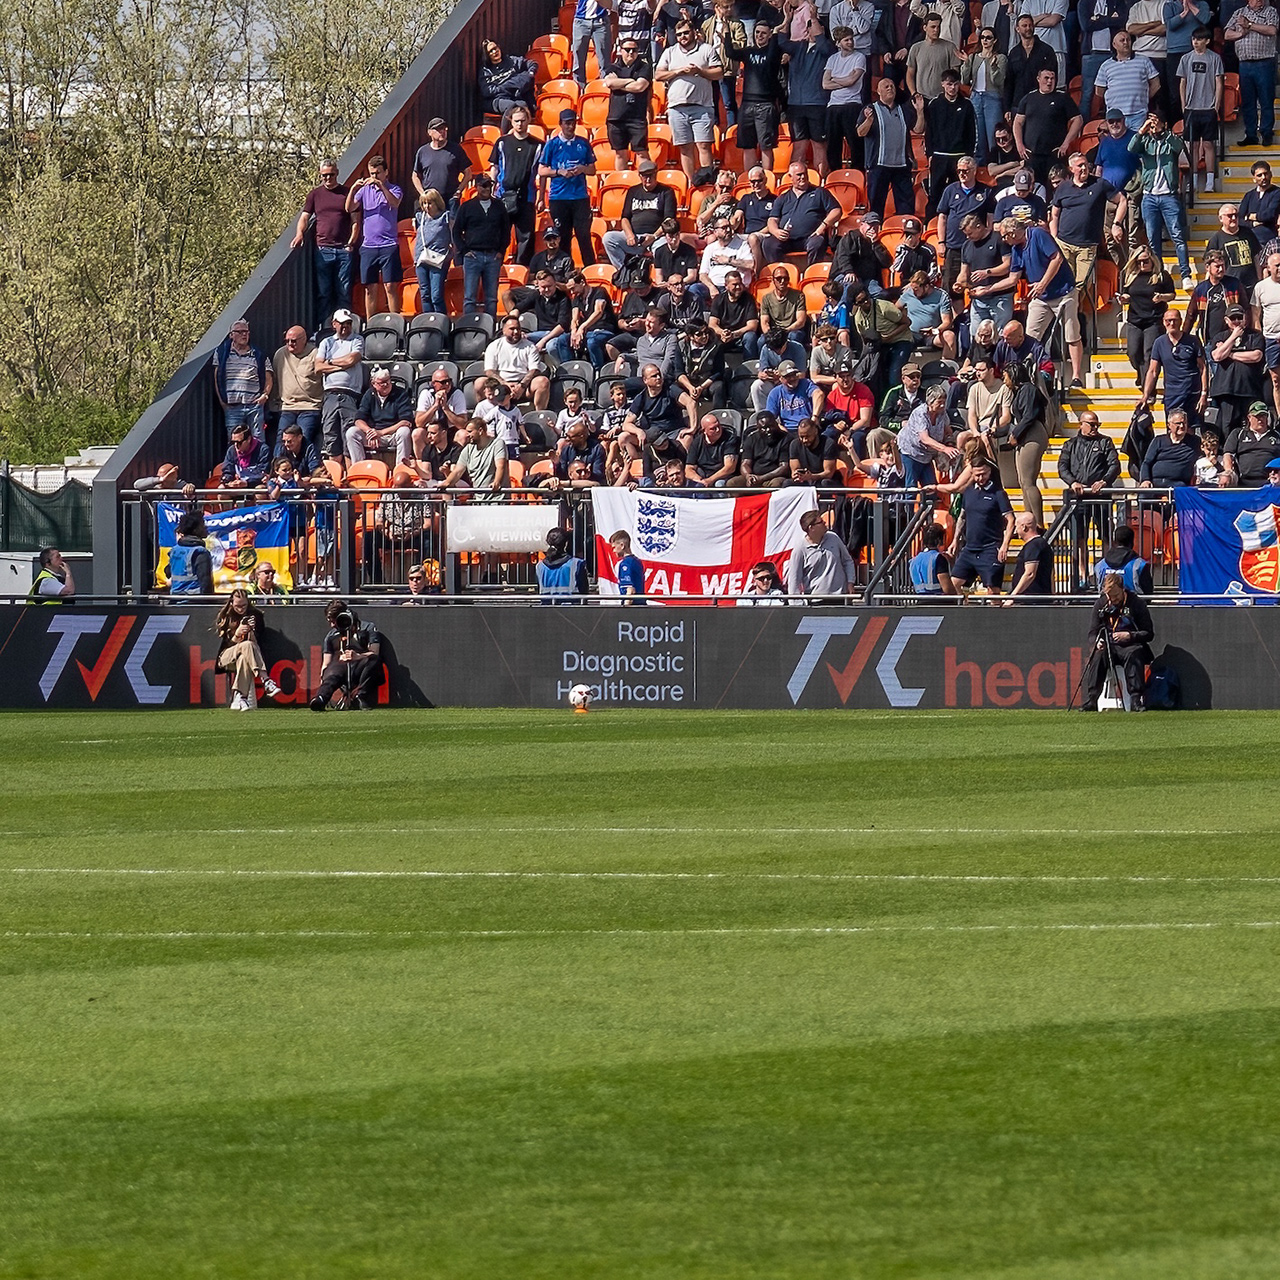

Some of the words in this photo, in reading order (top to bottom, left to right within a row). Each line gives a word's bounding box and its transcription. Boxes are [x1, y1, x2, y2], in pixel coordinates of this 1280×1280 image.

[474, 516, 556, 527] WHEELCHAIR
[488, 531, 542, 542] VIEWING
[618, 620, 684, 648] Rapid
[562, 650, 684, 678] Diagnostic
[944, 646, 1084, 707] heal
[556, 679, 684, 702] Halthcare
